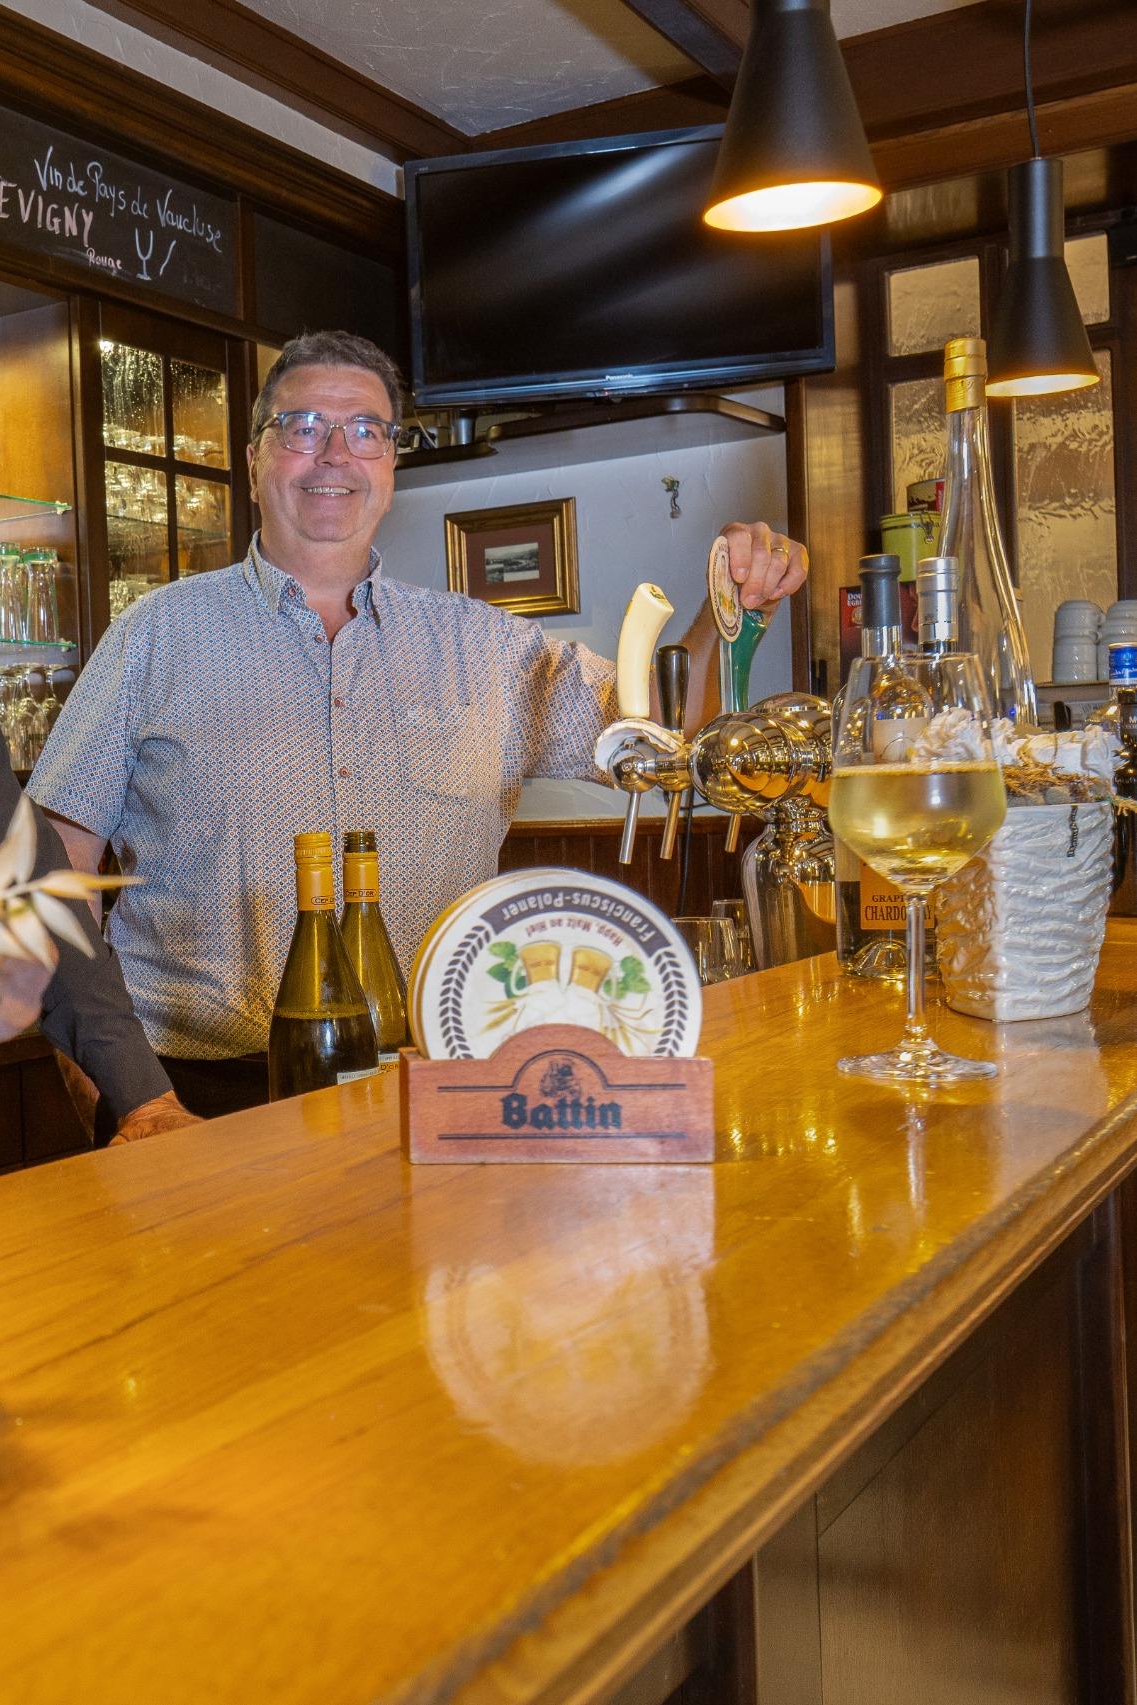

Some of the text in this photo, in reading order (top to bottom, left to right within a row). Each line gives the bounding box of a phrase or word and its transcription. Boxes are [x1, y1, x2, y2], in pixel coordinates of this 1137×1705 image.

[34, 146, 222, 252] Vin de Pays de Vaucluse
[87, 248, 122, 274] Rouge
[500, 1092, 623, 1130] Battin
